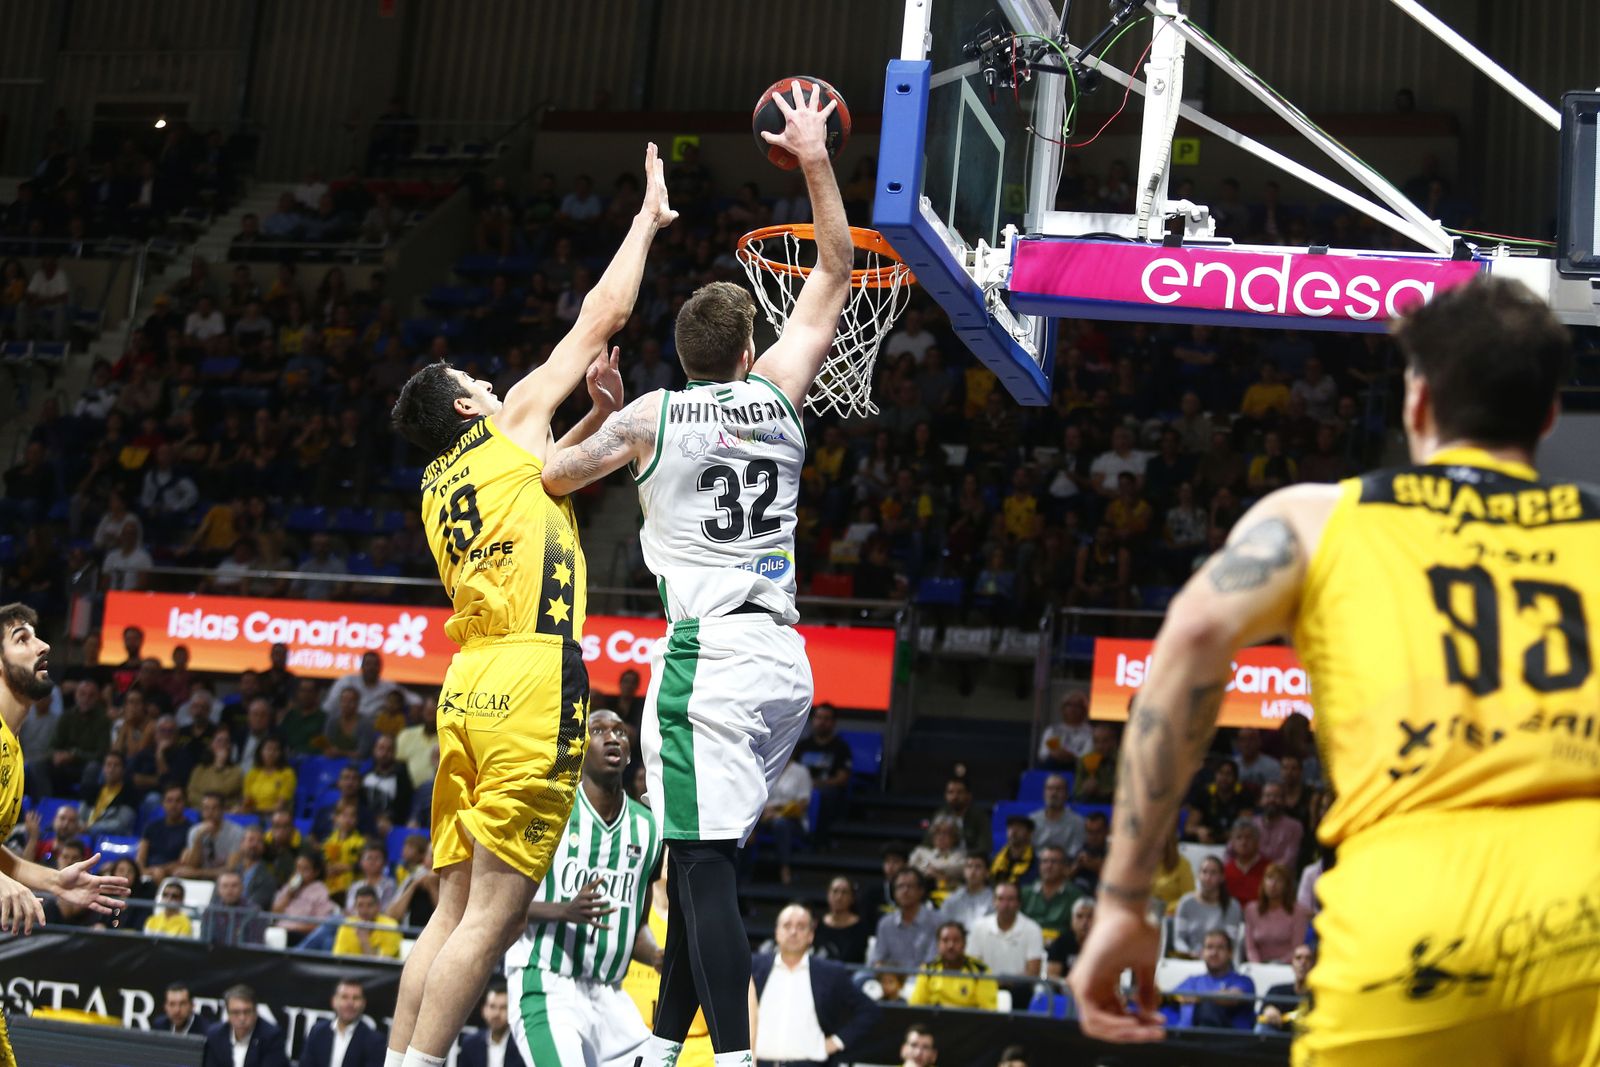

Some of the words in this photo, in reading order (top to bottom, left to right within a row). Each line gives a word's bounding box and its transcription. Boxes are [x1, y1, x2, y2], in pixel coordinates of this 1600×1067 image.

[1141, 254, 1435, 320] endesa
[697, 459, 781, 543] 32
[760, 559, 785, 575] plus
[167, 607, 239, 641] Islas
[243, 611, 384, 650] Canarias
[1425, 563, 1593, 696] 93
